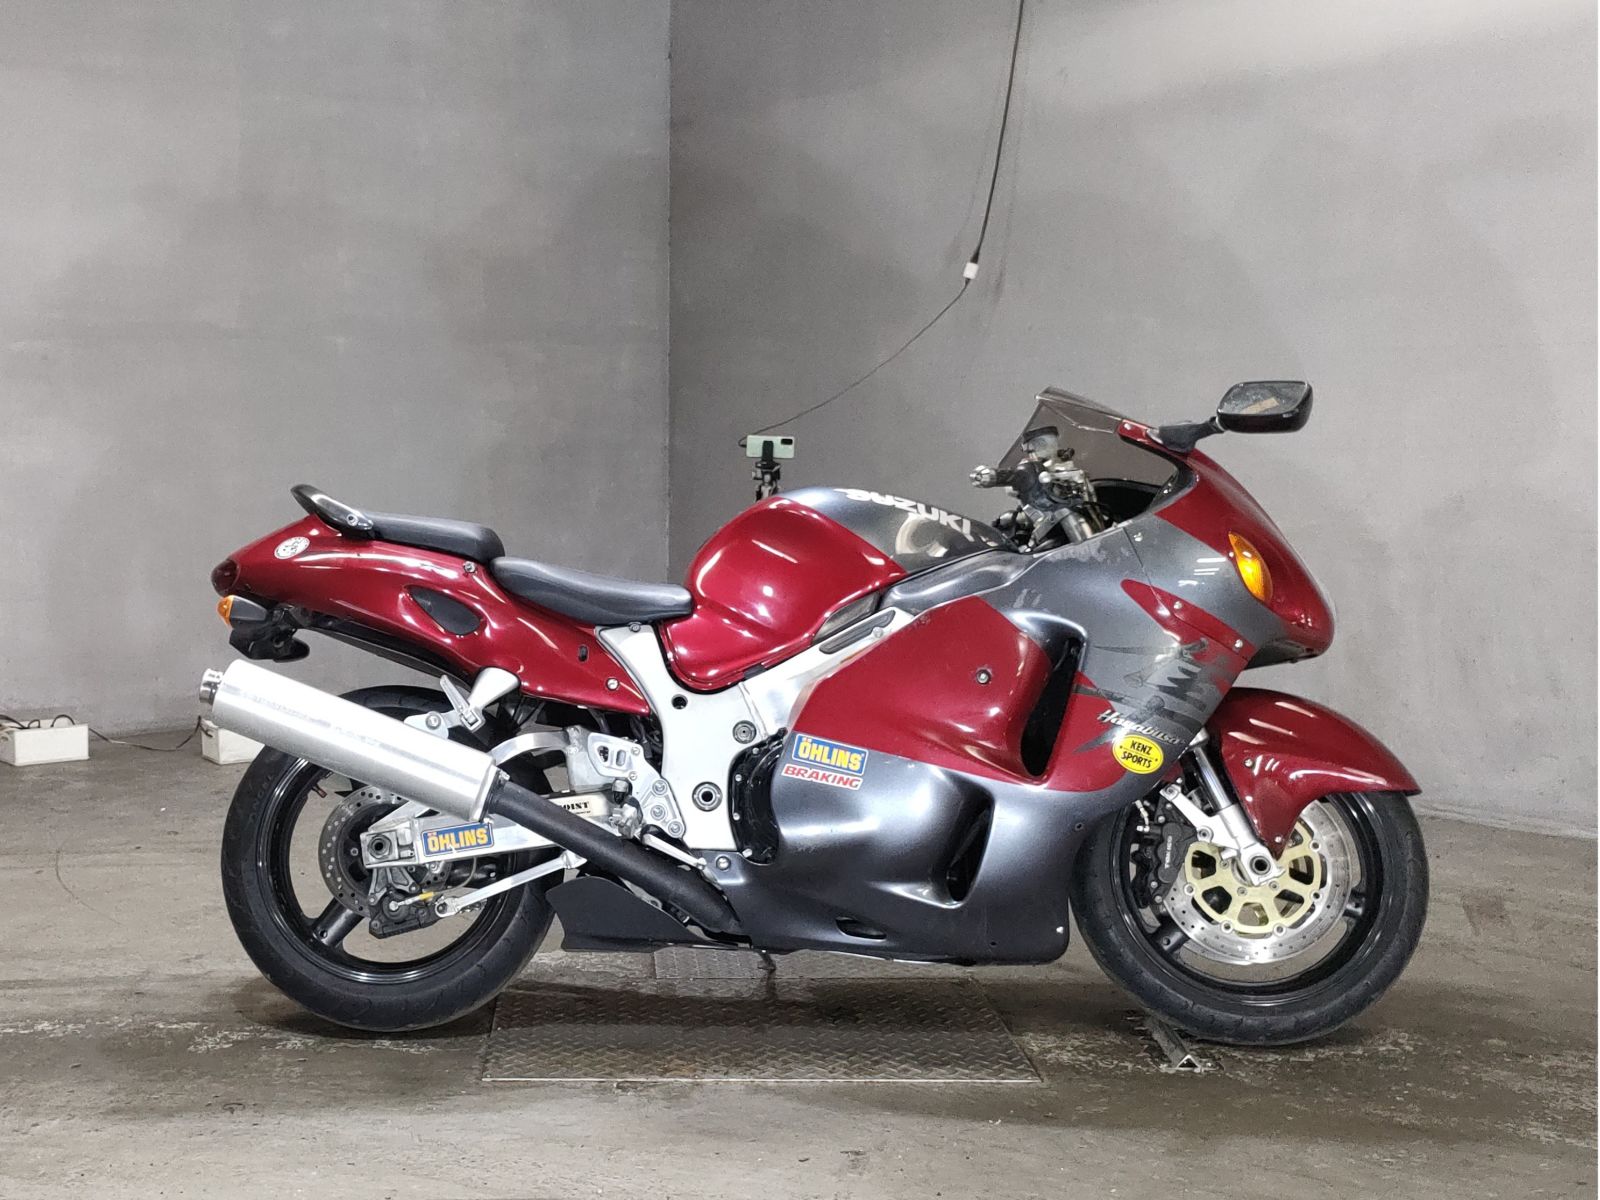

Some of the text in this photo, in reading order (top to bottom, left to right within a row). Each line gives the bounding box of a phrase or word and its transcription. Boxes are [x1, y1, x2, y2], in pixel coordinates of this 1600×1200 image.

[833, 488, 975, 542] SUZUKI
[1096, 709, 1180, 745] Hayabusa
[798, 737, 862, 771] ÖHLINS
[1121, 751, 1153, 768] SPORTS
[1130, 740, 1153, 755] KENZ
[784, 765, 861, 788] BRAKING
[427, 828, 489, 853] ÖHLINS
